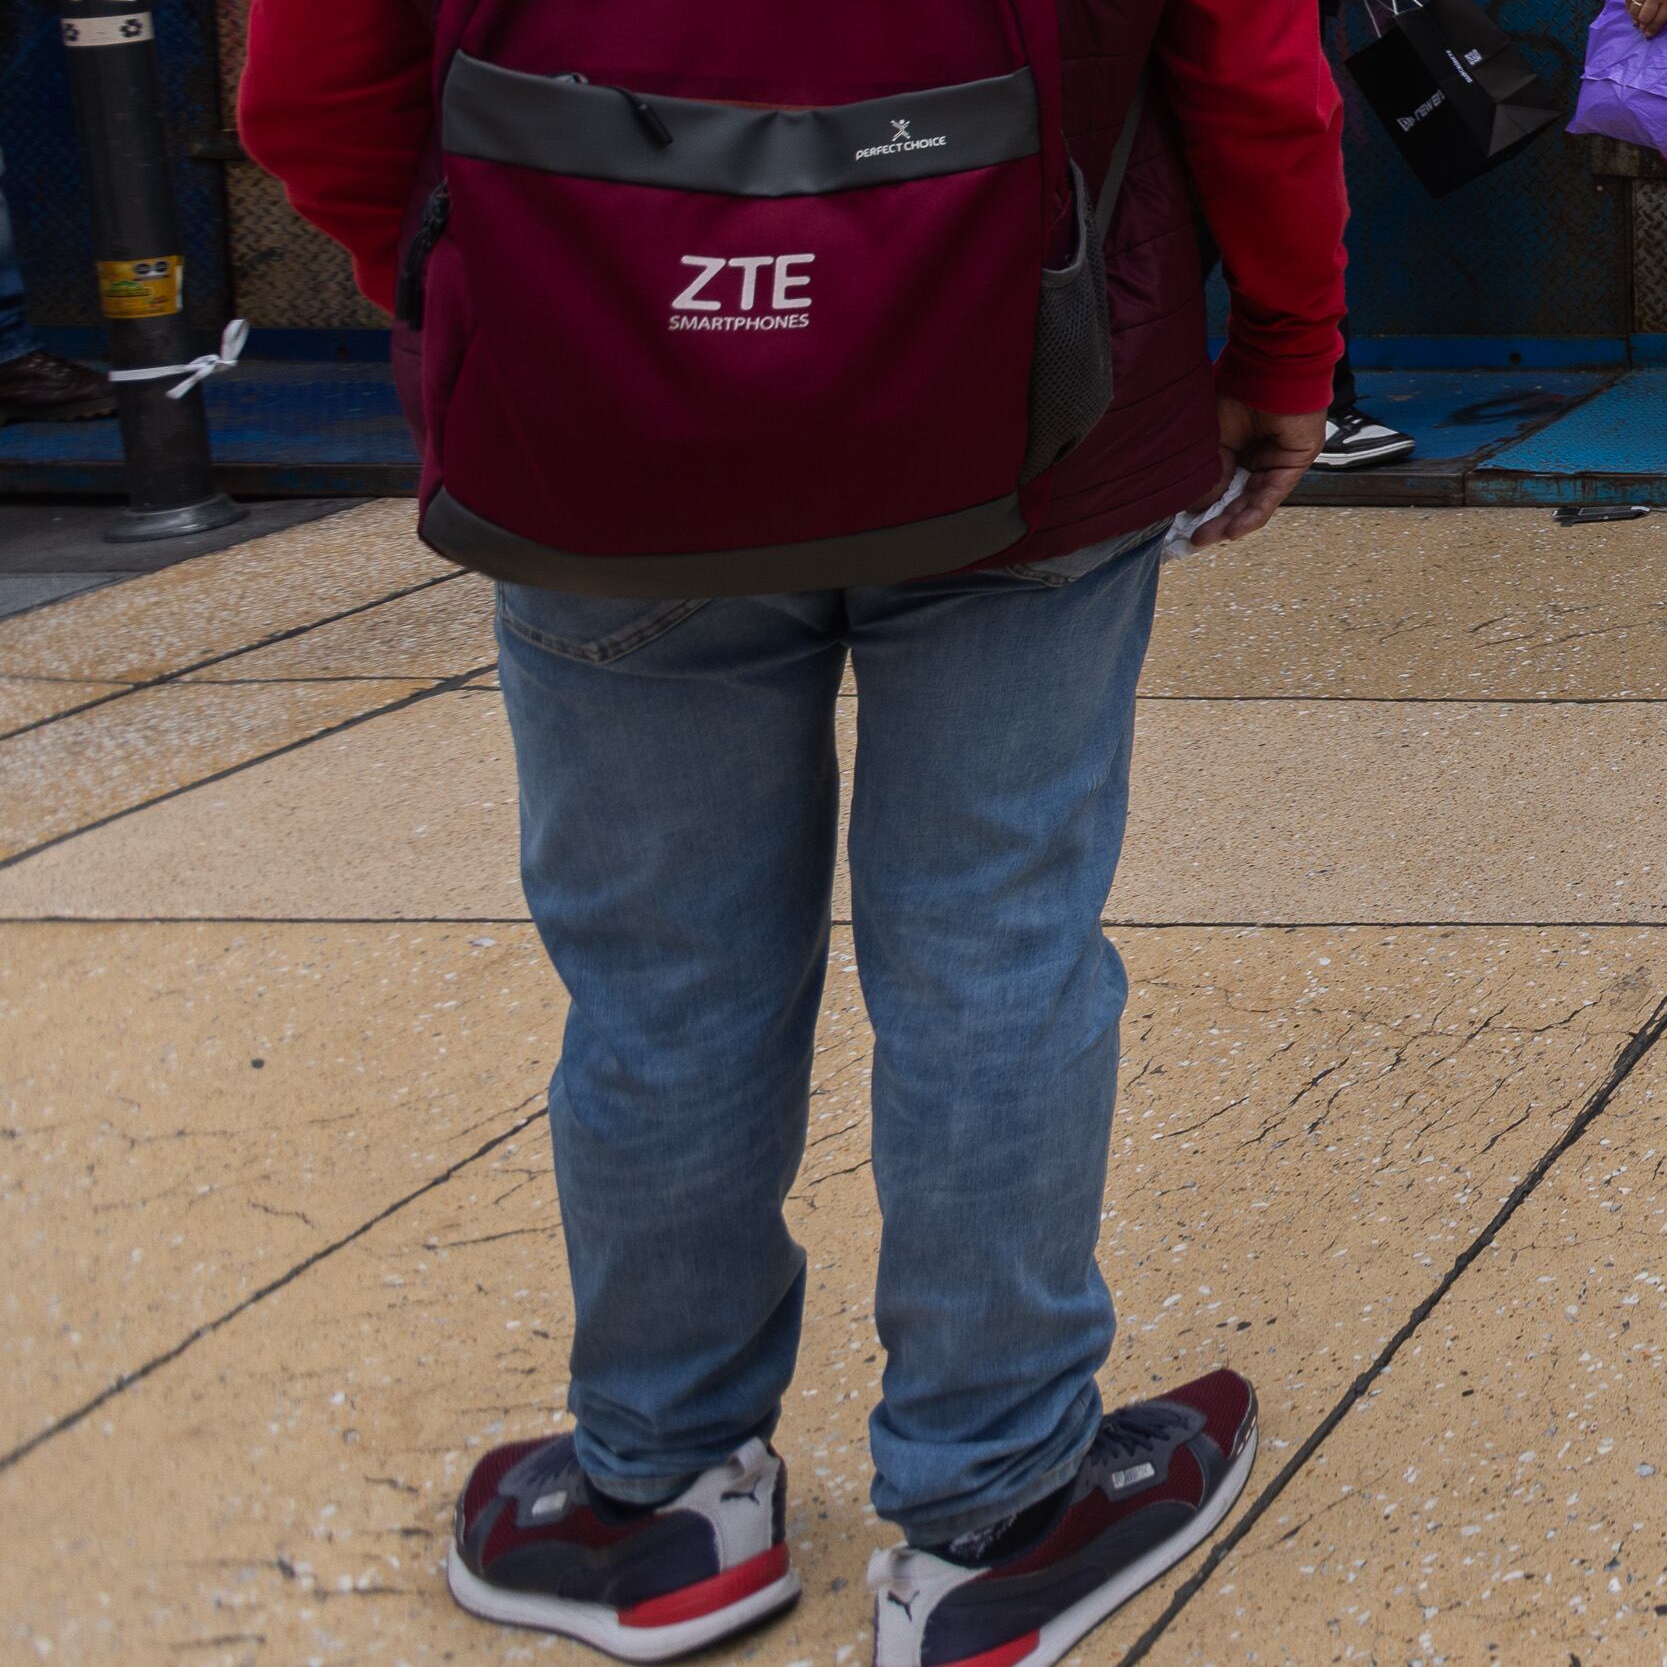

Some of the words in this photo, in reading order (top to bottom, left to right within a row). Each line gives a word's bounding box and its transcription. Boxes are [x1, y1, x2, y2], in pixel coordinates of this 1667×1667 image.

[856, 143, 903, 161] PERFECT
[904, 136, 947, 151] CHOICE
[671, 253, 816, 311] ZTE
[668, 314, 809, 332] SMARTPHONES
